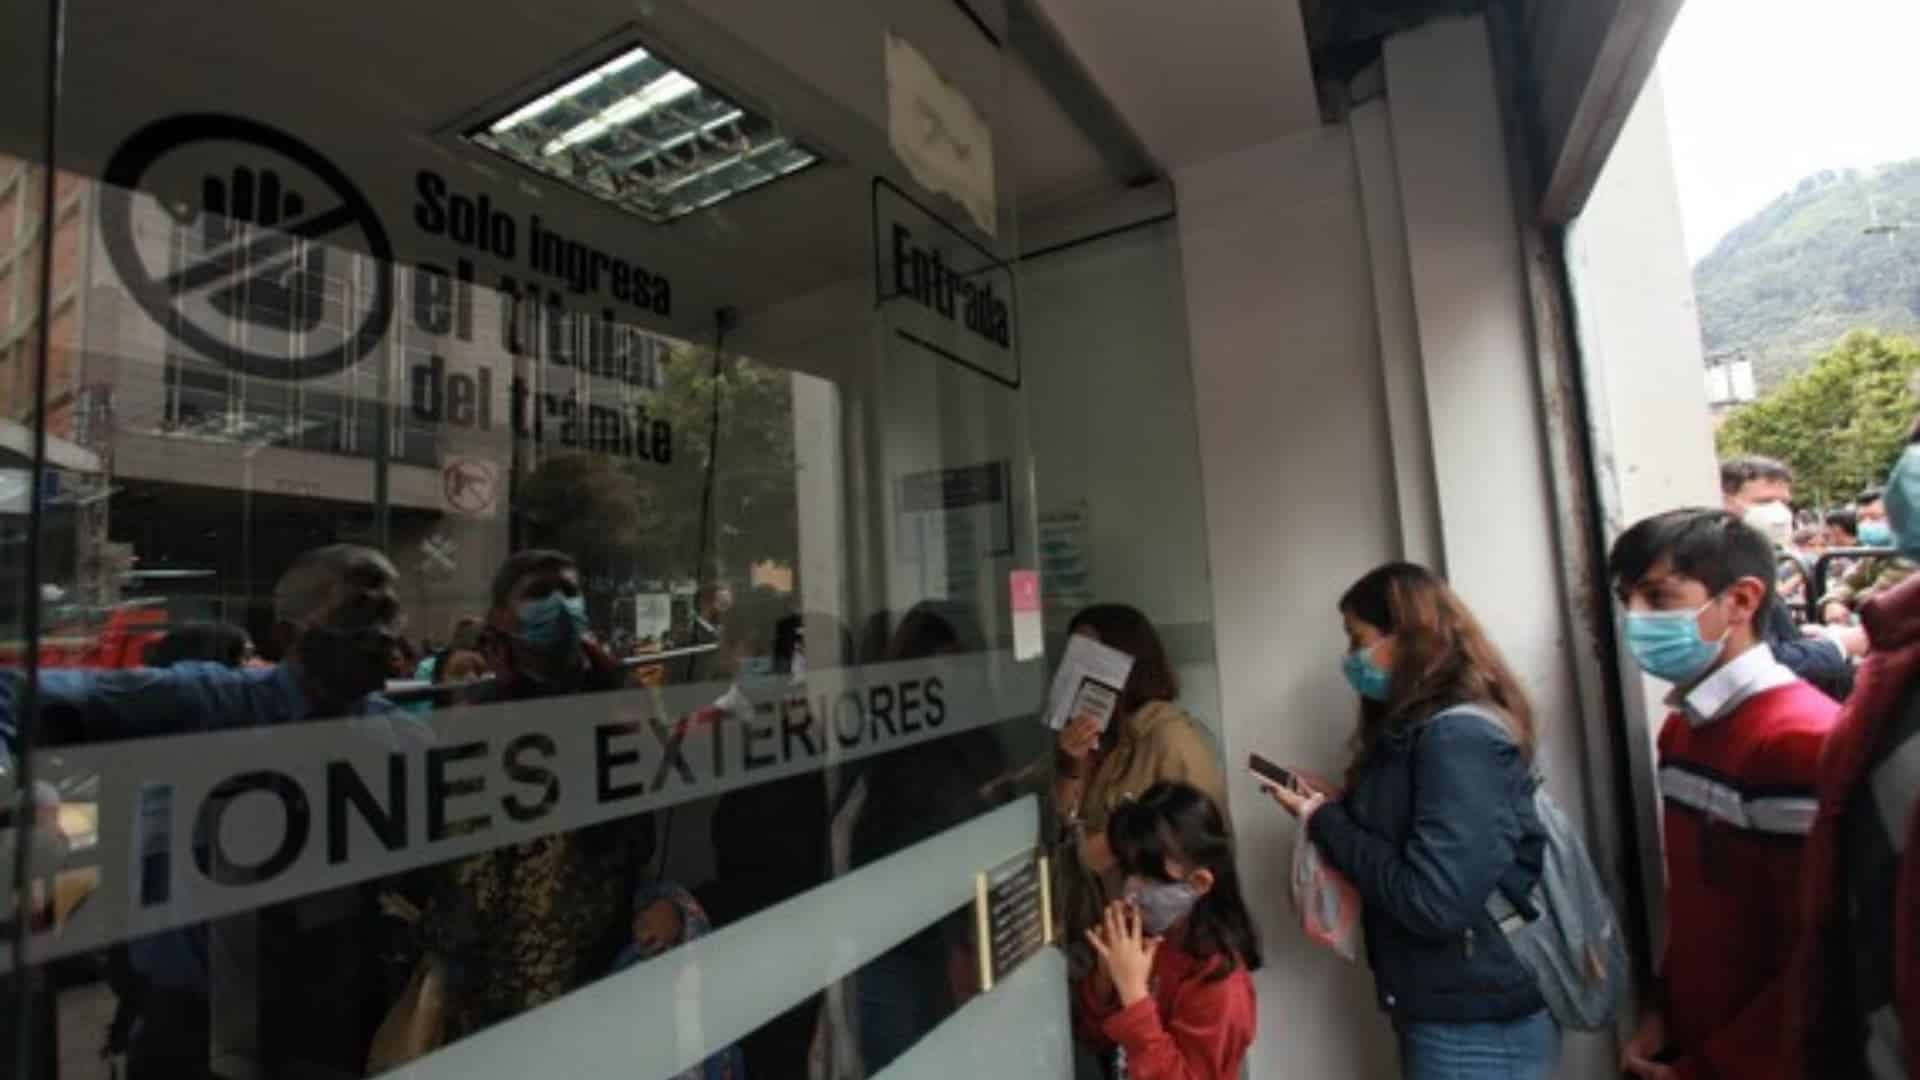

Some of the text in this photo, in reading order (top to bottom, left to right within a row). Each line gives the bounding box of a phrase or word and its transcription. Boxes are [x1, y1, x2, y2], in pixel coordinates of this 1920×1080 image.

[414, 170, 672, 316] Solo ingresa
[414, 258, 475, 342] el
[893, 221, 1010, 349] Entrada
[411, 355, 672, 465] del trámite
[594, 675, 945, 805] EXTERIORES
